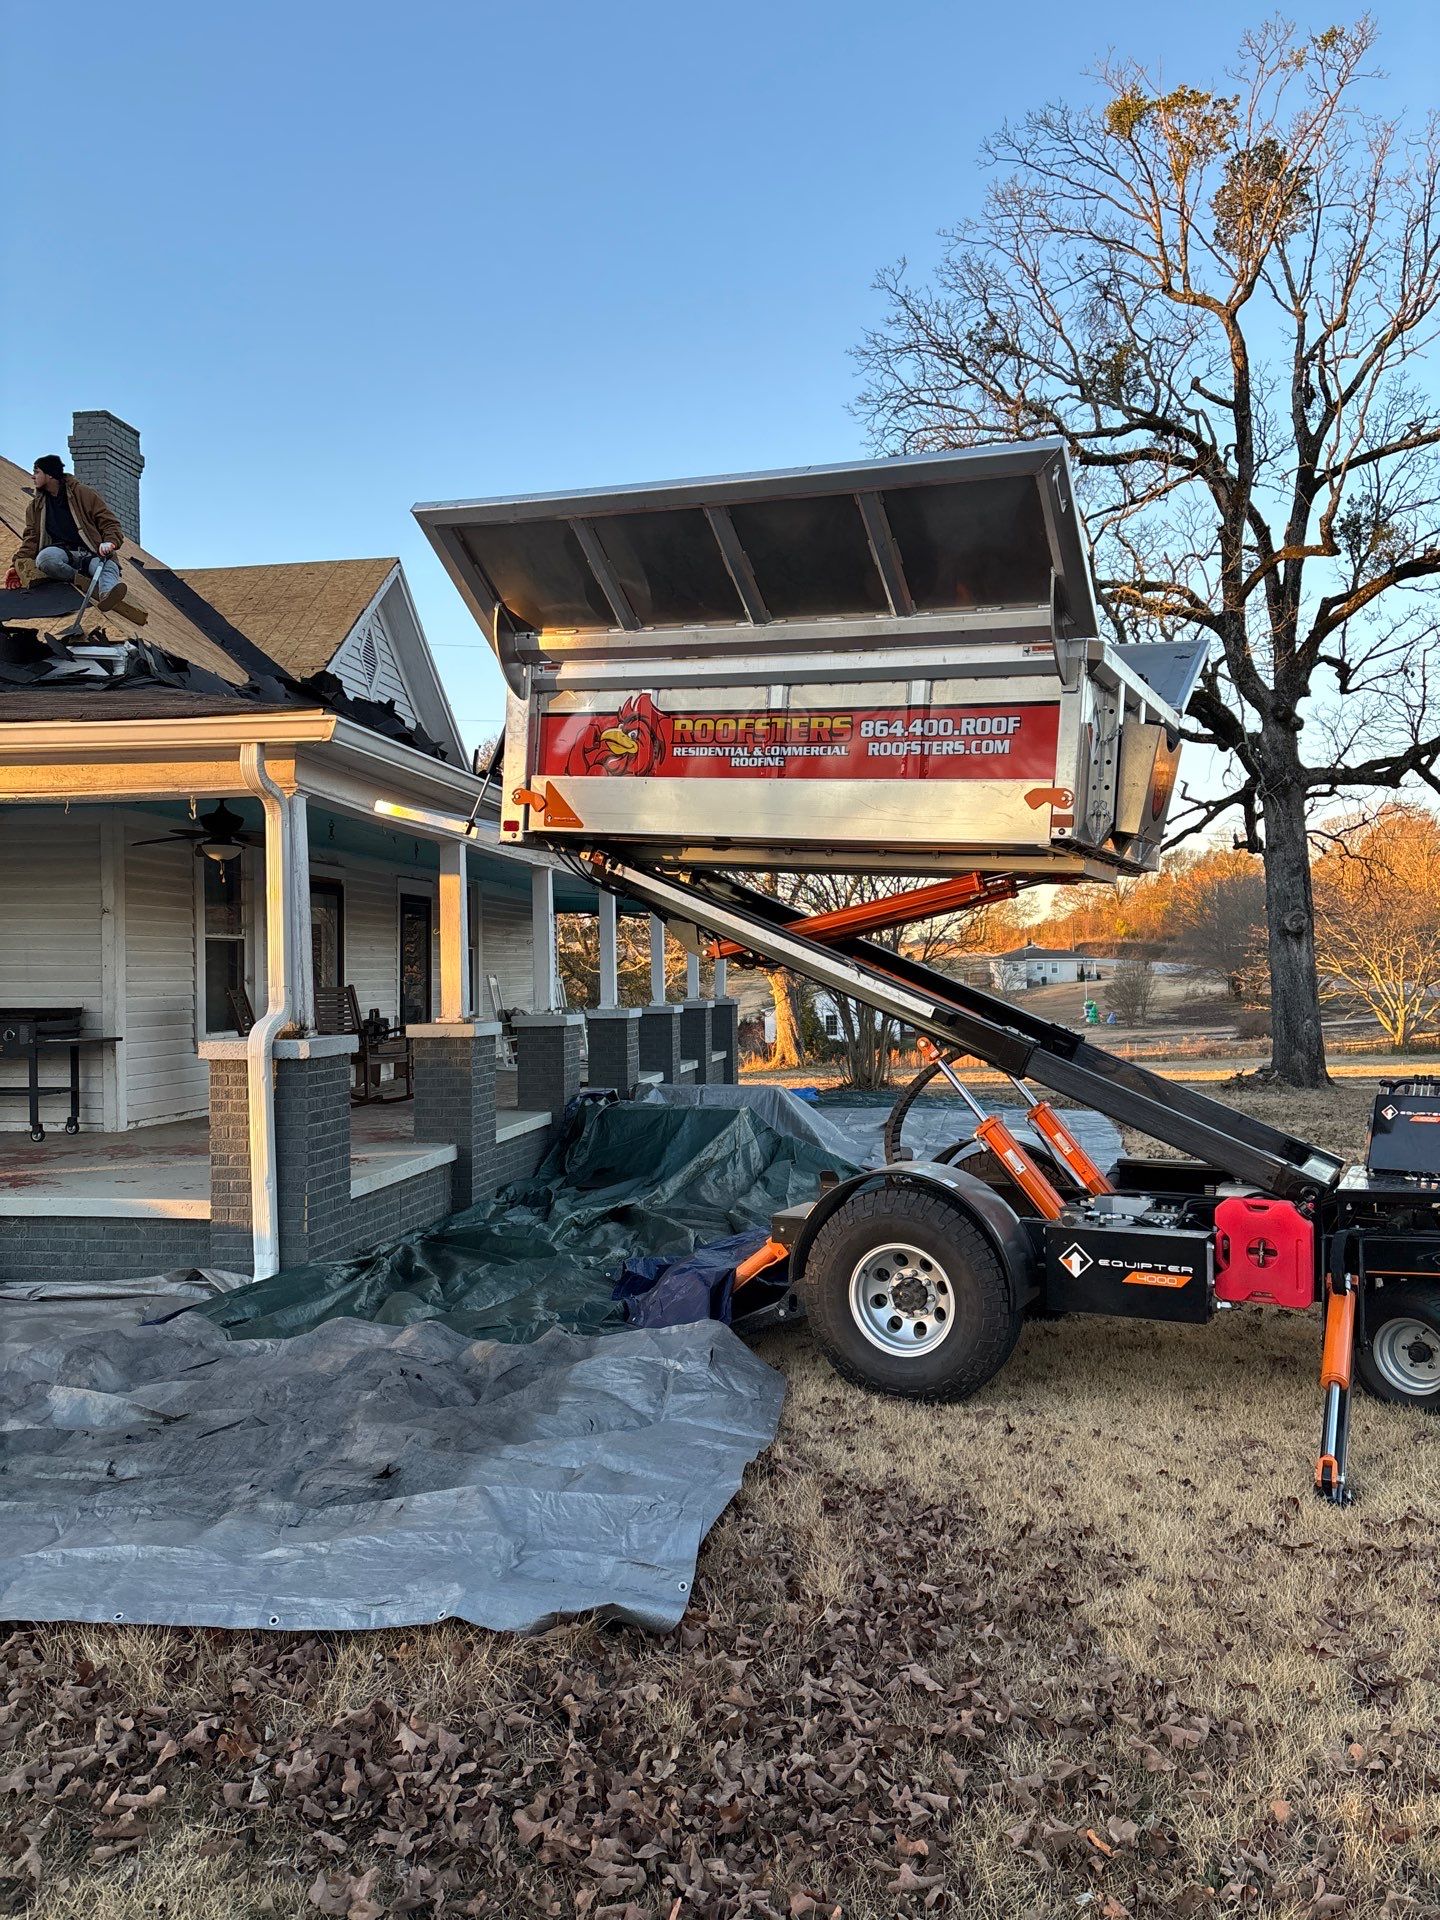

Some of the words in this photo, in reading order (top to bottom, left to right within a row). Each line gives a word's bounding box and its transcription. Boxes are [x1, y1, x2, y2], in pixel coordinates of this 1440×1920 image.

[672, 716, 853, 744] ROOFSTERS
[860, 716, 1020, 738] 864.400.ROOF
[673, 746, 749, 756] RESIDENTIAL
[753, 746, 764, 756] &
[765, 745, 848, 756] COMMERCIAL
[867, 739, 1010, 756] ROOFSTERS.COM
[731, 756, 785, 767] ROOFING
[1098, 1259, 1194, 1274] EQUIPTER
[1136, 1274, 1178, 1285] 4000
